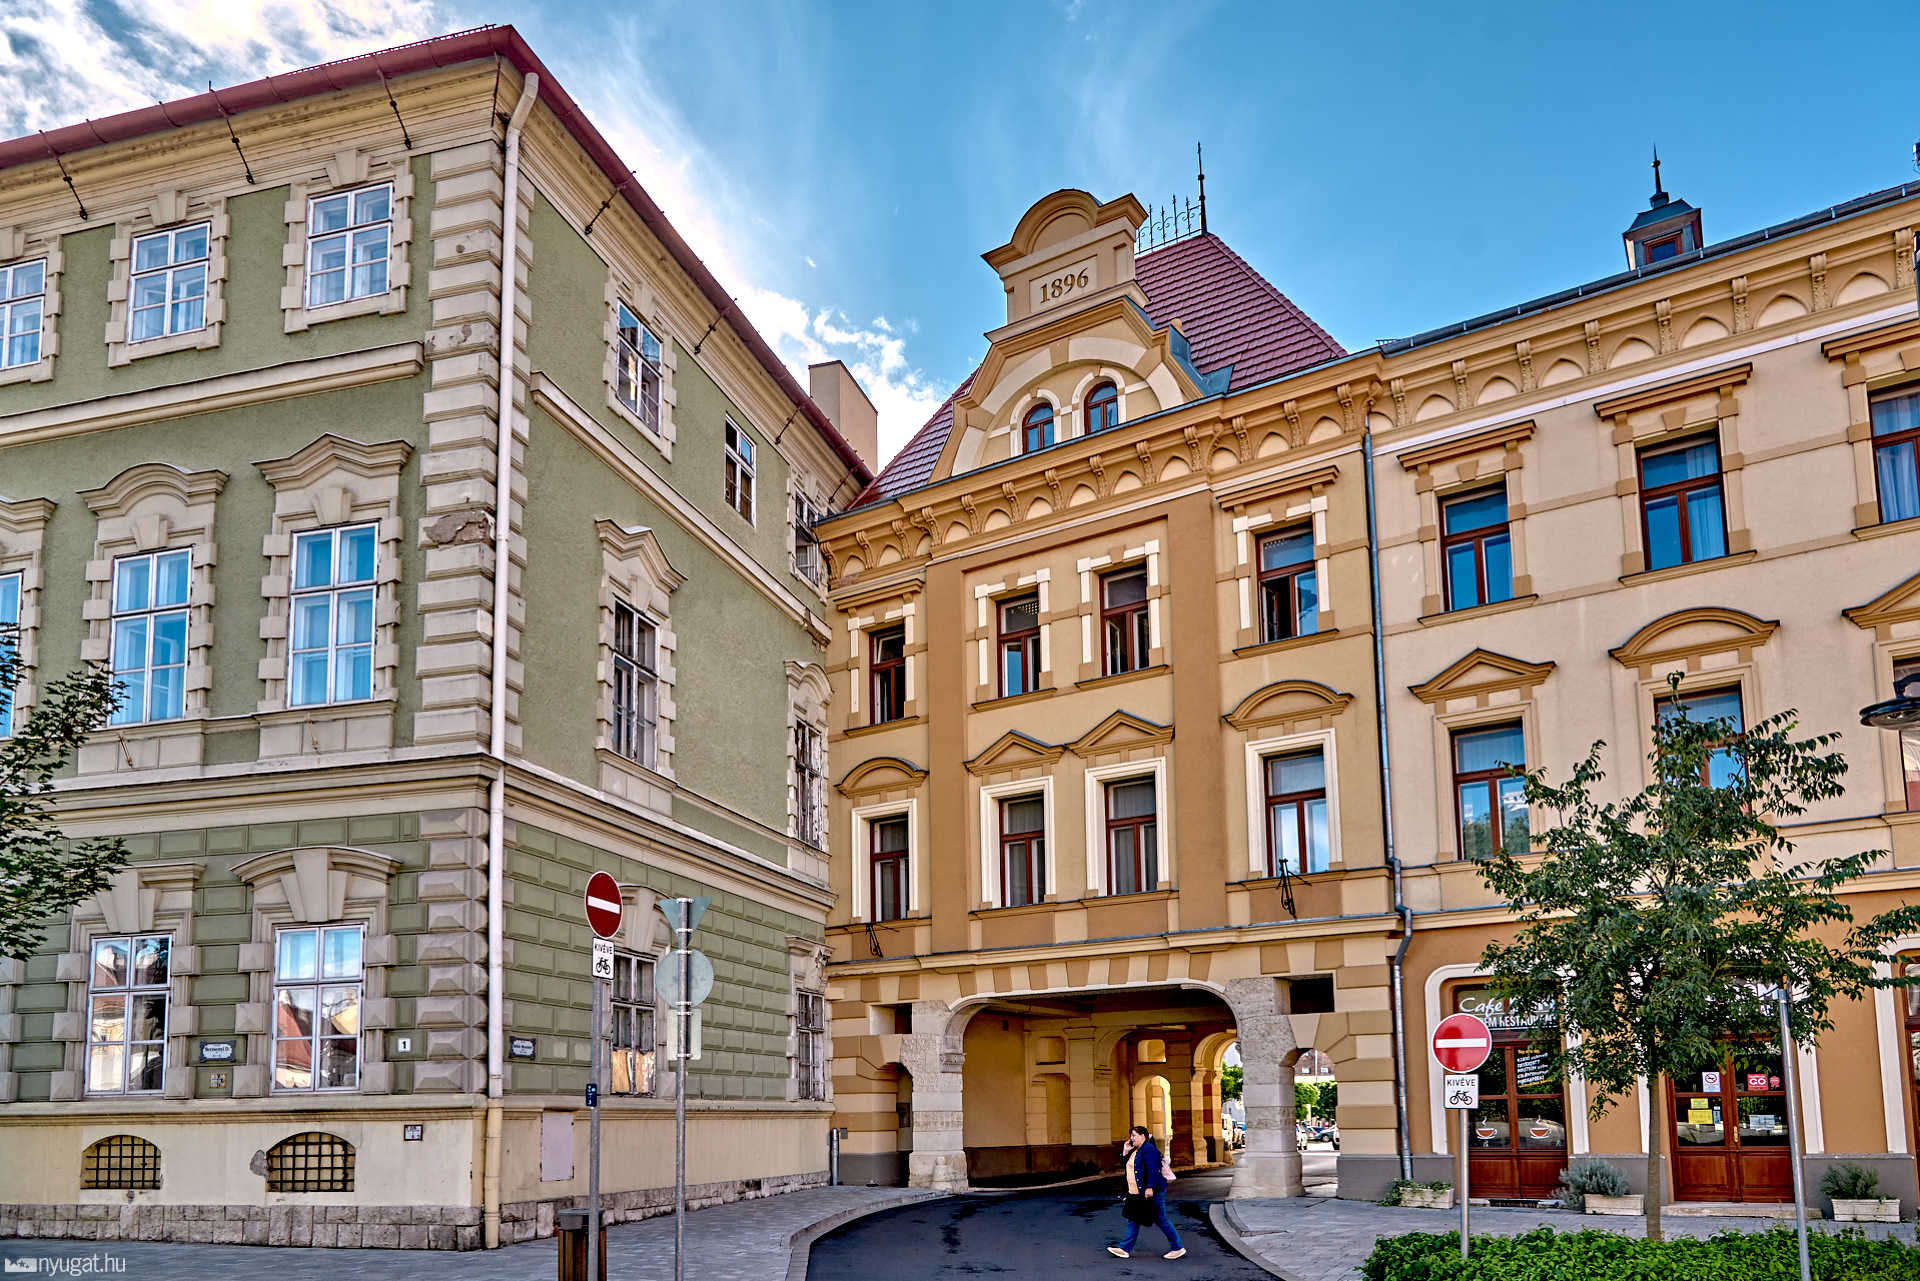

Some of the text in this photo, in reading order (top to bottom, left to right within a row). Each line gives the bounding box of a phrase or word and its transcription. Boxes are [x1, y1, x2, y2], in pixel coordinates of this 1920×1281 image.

[1040, 267, 1088, 303] 1896
[402, 1040, 407, 1049] 1
[1447, 1078, 1476, 1087] KIVÉVE
